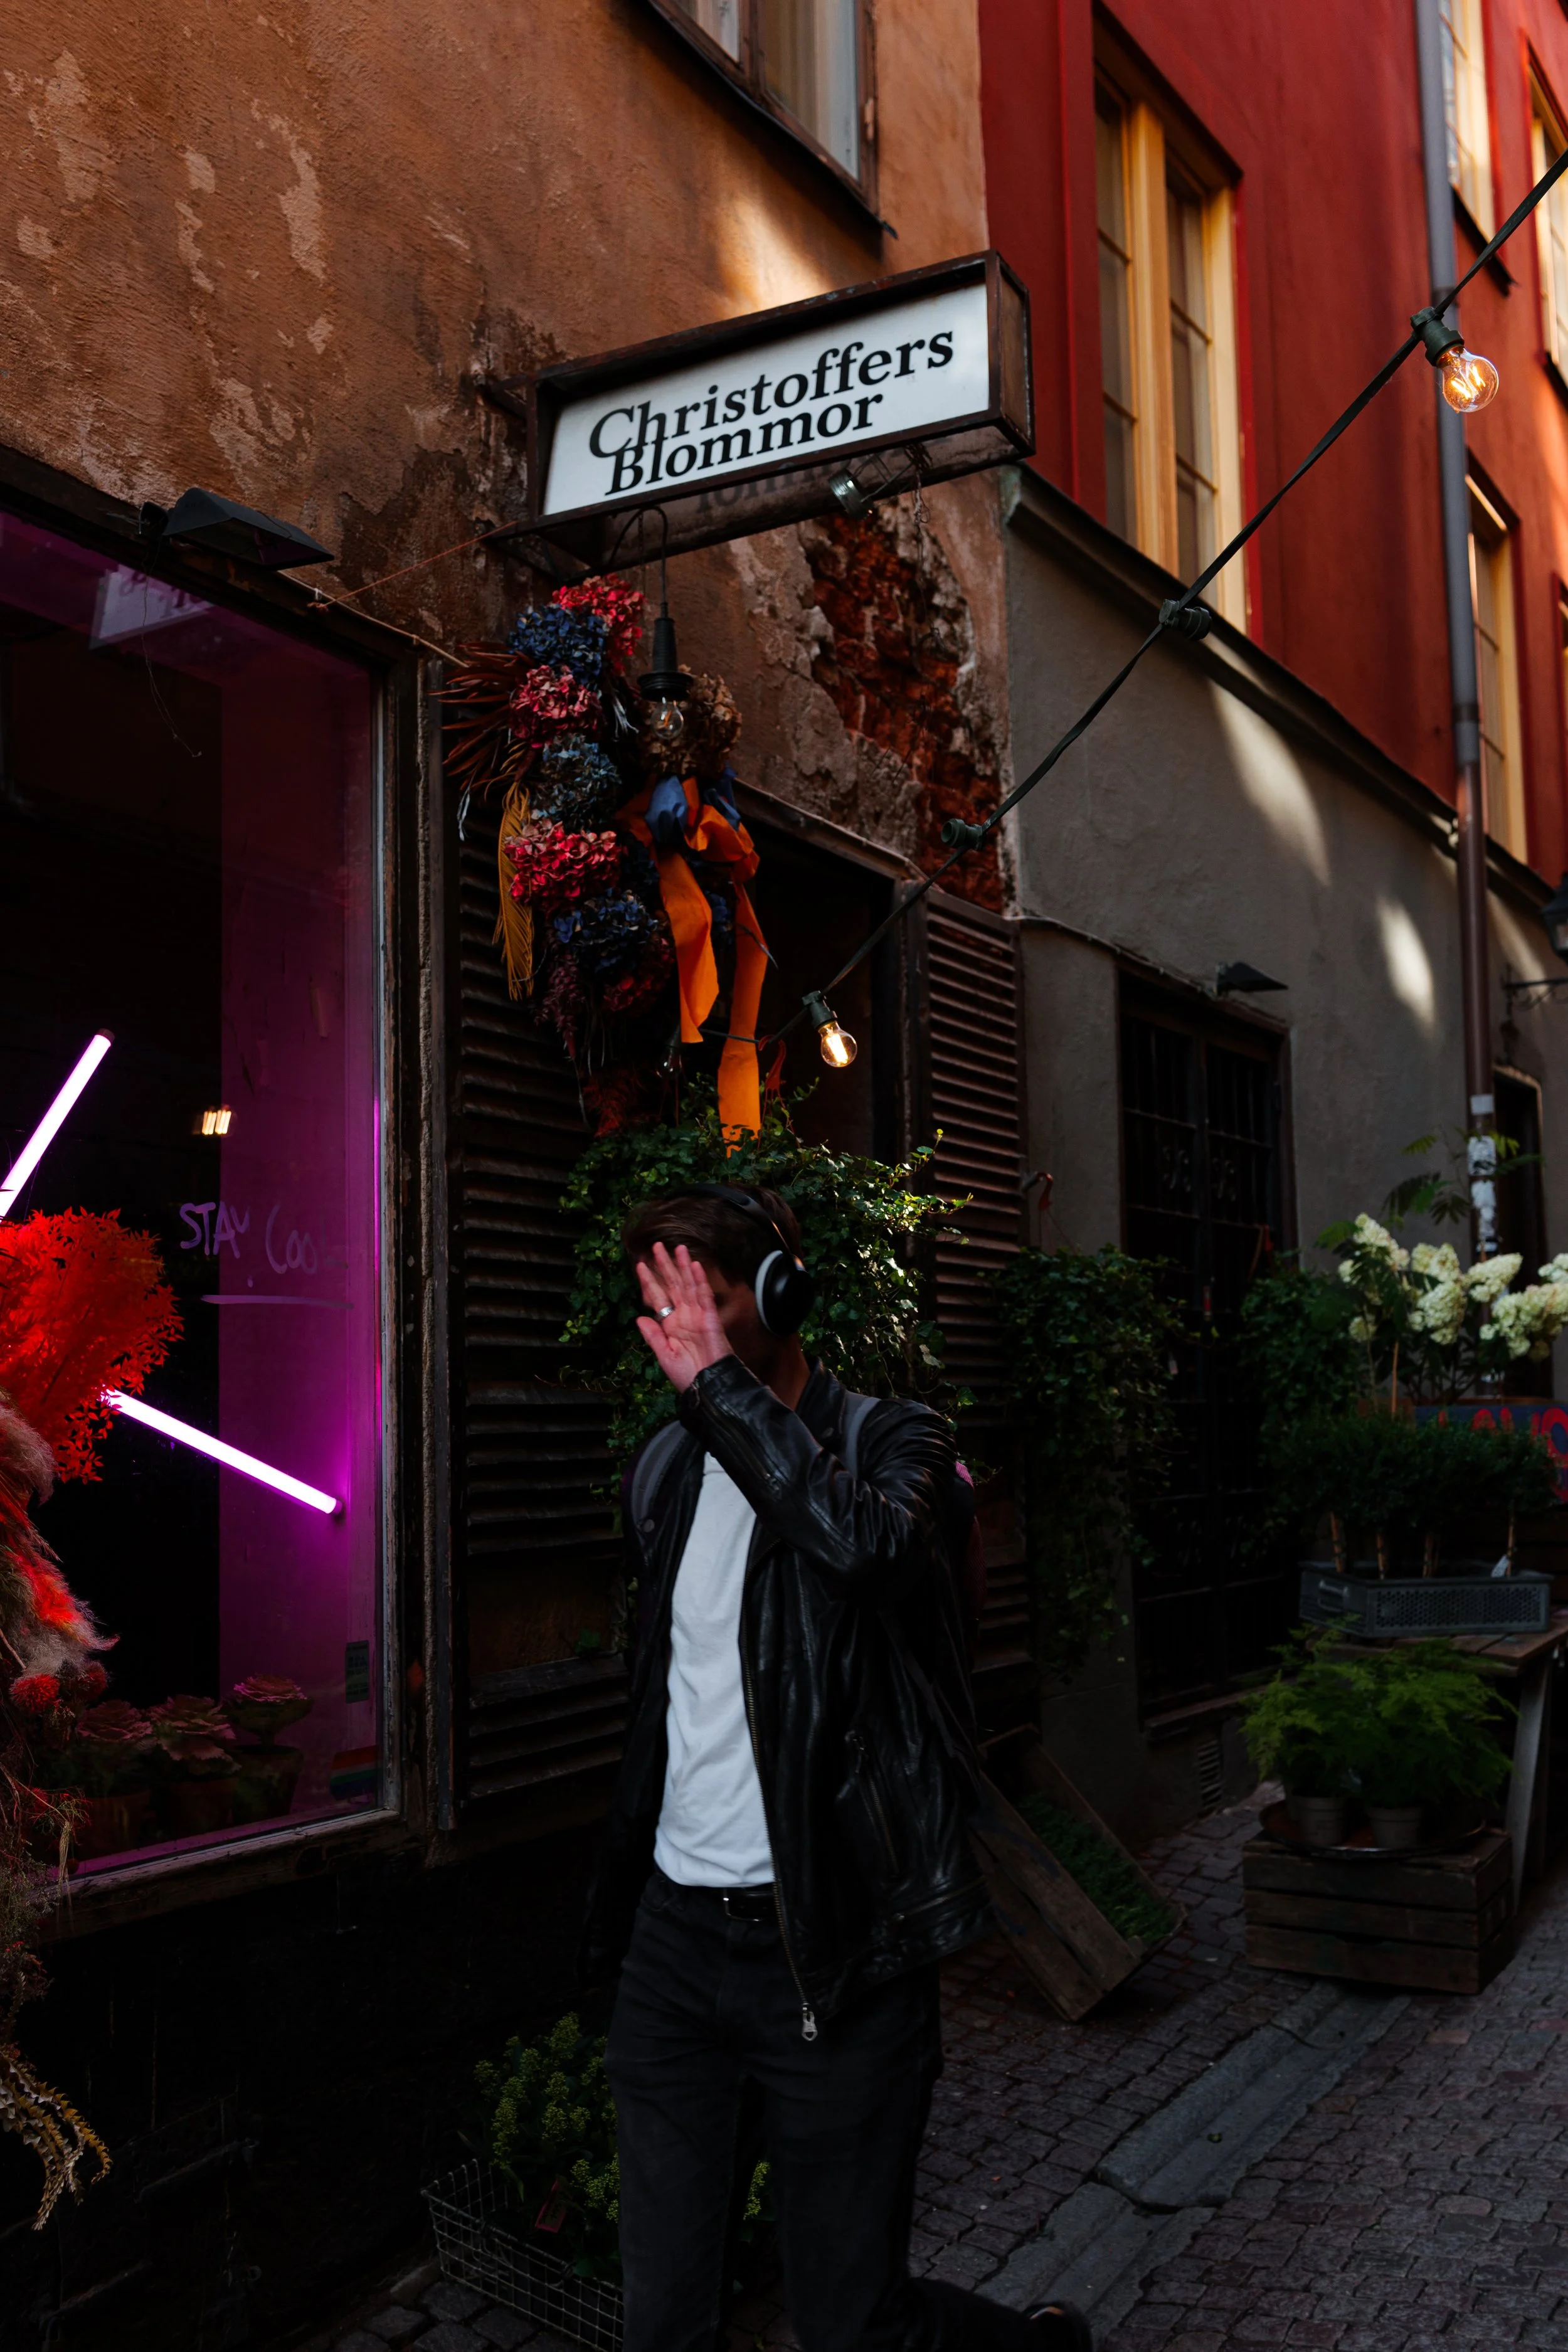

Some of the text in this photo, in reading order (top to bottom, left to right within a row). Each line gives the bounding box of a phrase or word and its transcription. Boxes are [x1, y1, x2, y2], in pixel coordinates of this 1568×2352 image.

[589, 331, 953, 458] Christoffers
[605, 394, 883, 496] Blommor
[179, 1200, 250, 1259] STAY
